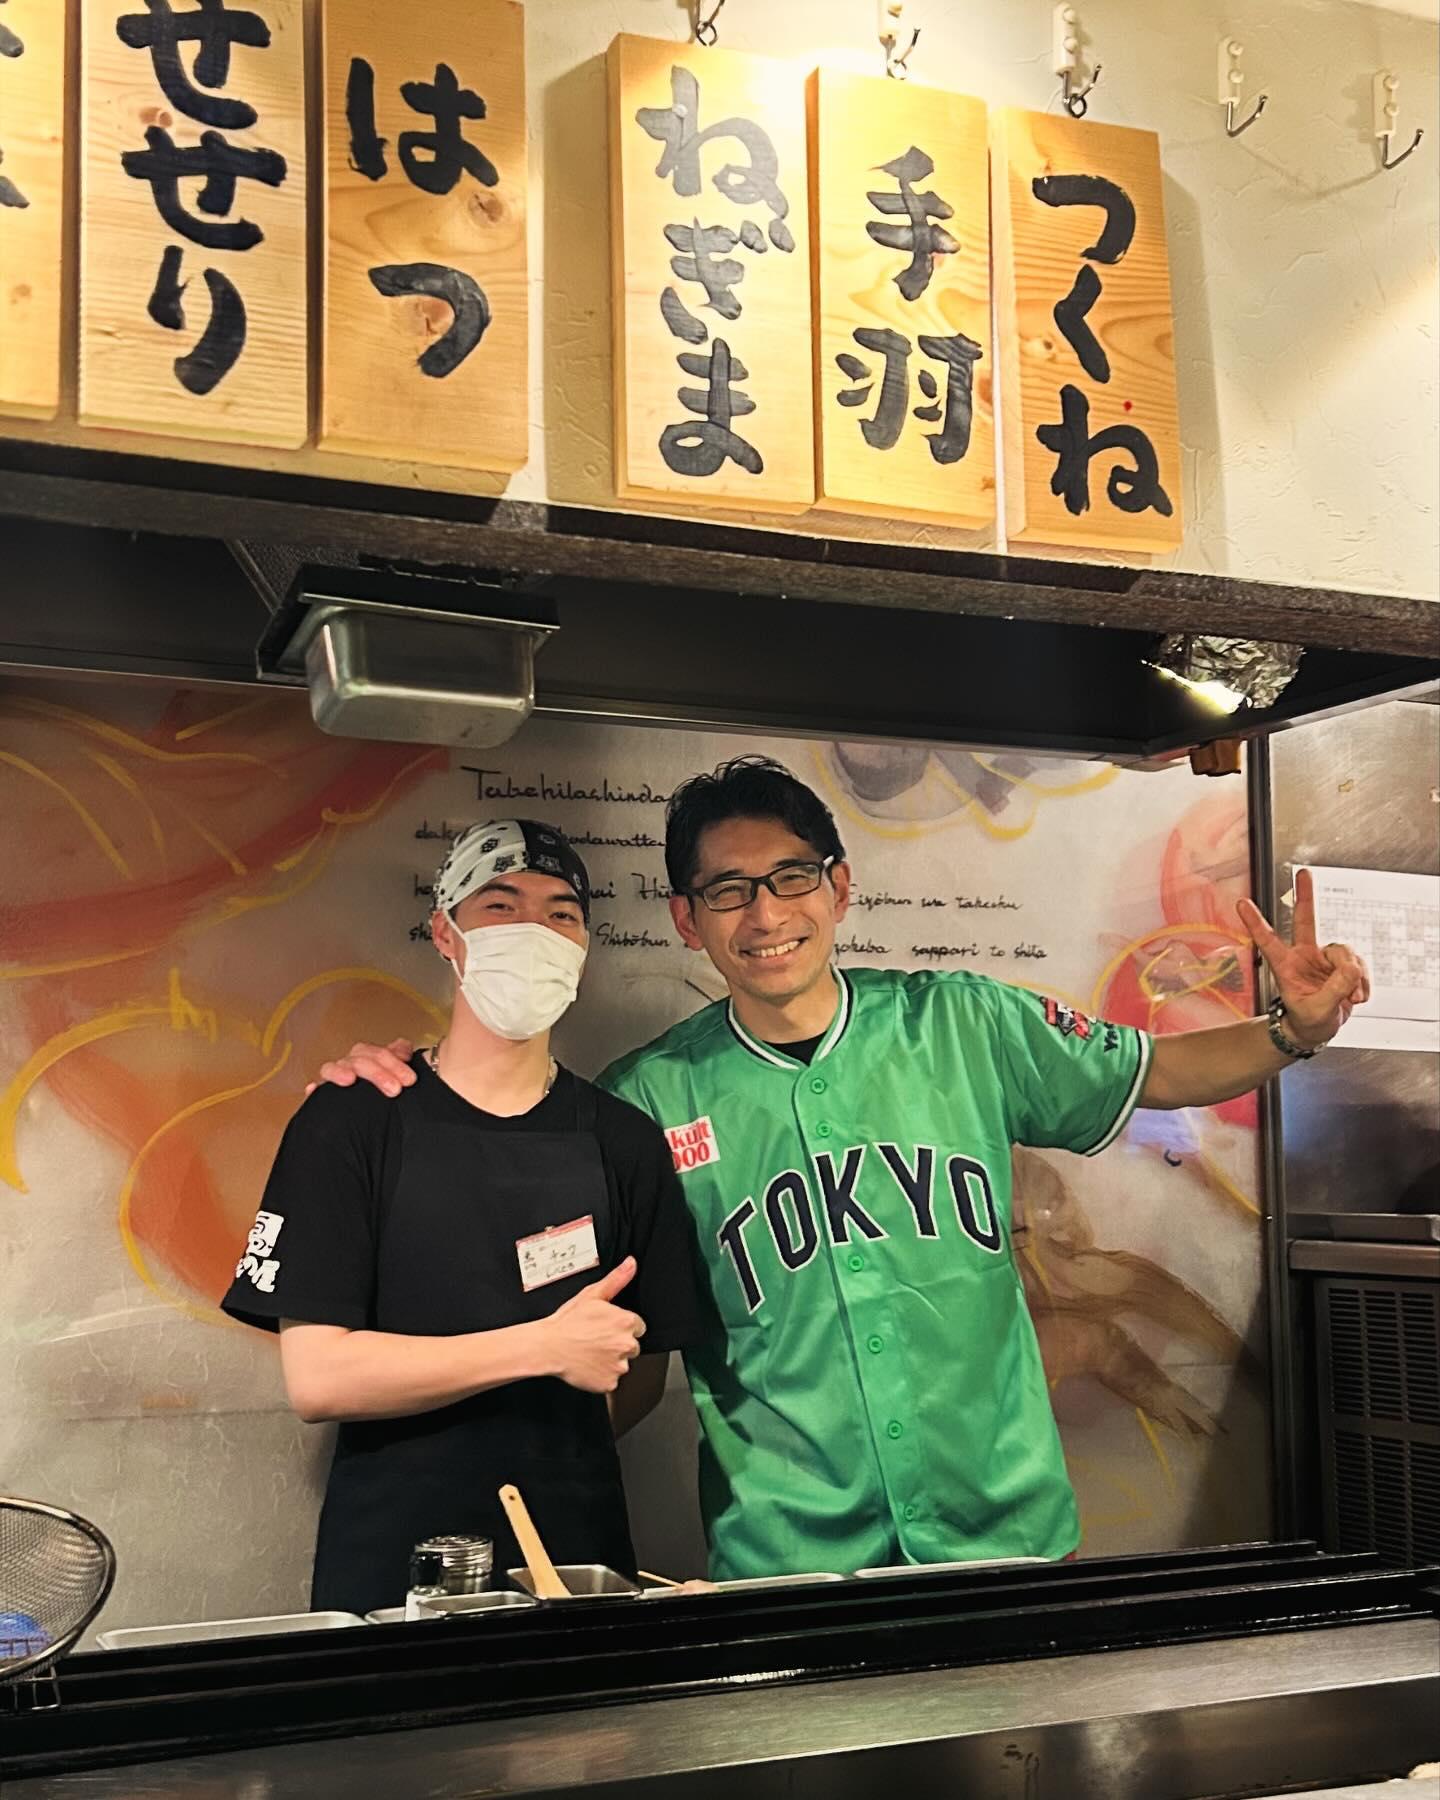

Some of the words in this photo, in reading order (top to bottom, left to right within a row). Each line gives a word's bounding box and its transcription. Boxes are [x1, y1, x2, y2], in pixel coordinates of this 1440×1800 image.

[116, 0, 287, 395] せせり
[346, 57, 500, 379] はつ
[636, 65, 795, 477] ねぎま
[836, 146, 983, 465] 手羽
[1032, 174, 1174, 517] つくね
[717, 1142, 1002, 1315] TOKYO
